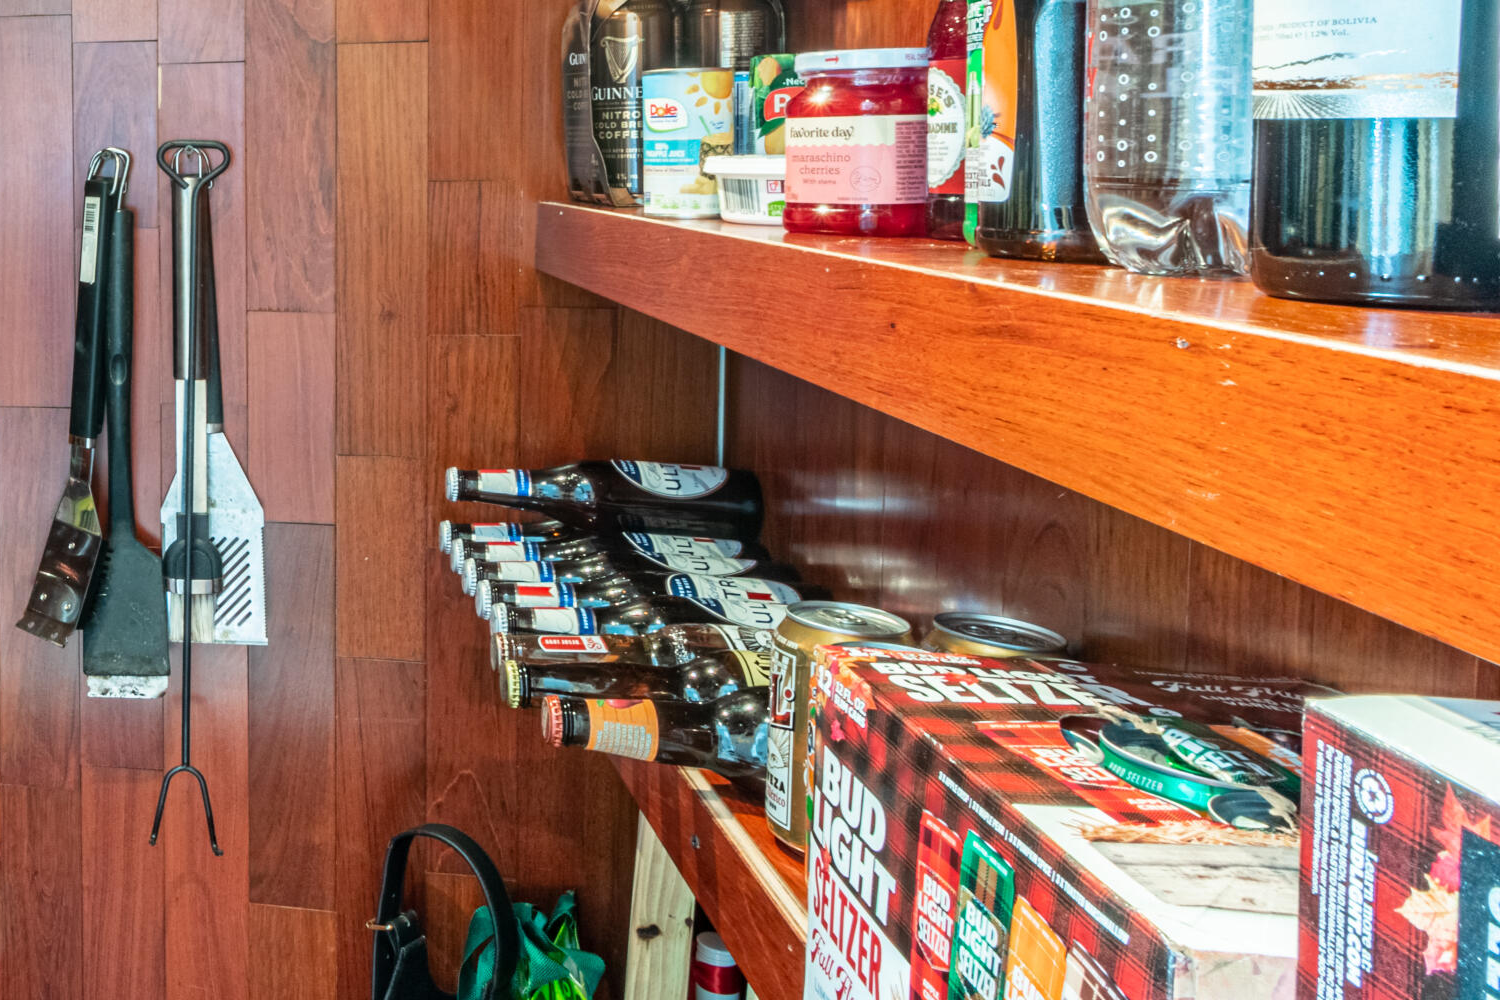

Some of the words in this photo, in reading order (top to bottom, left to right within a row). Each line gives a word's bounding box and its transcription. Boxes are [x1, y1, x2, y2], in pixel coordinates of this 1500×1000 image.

[1278, 20, 1315, 30] PRODUCT
[1317, 19, 1331, 27] OF
[1332, 16, 1378, 27] BOLIVIA
[1310, 29, 1329, 39] 12%
[595, 121, 617, 129] COLD
[602, 110, 641, 120] NITRO
[650, 103, 678, 118] Dole
[790, 126, 833, 139] favorite
[834, 125, 855, 142] day
[792, 151, 851, 164] maraschino
[799, 163, 841, 176] cherries
[817, 666, 833, 698] 12
[870, 661, 968, 677] BUD
[823, 745, 887, 854] BUD
[1125, 770, 1164, 794] SELTZER
[813, 788, 897, 926] LIGHT
[1363, 849, 1379, 903] Learn
[923, 874, 951, 911] BUD
[1346, 818, 1368, 989] BUDLIGHT.COM
[813, 856, 883, 1000] SELTZER
[917, 891, 953, 936] LIGHT
[966, 900, 999, 949] BUD
[1362, 904, 1374, 950] more
[811, 927, 836, 978] Fall
[917, 918, 950, 965] SELTZER
[959, 924, 1002, 977] LIGHT
[958, 949, 997, 1000] SELTZER
